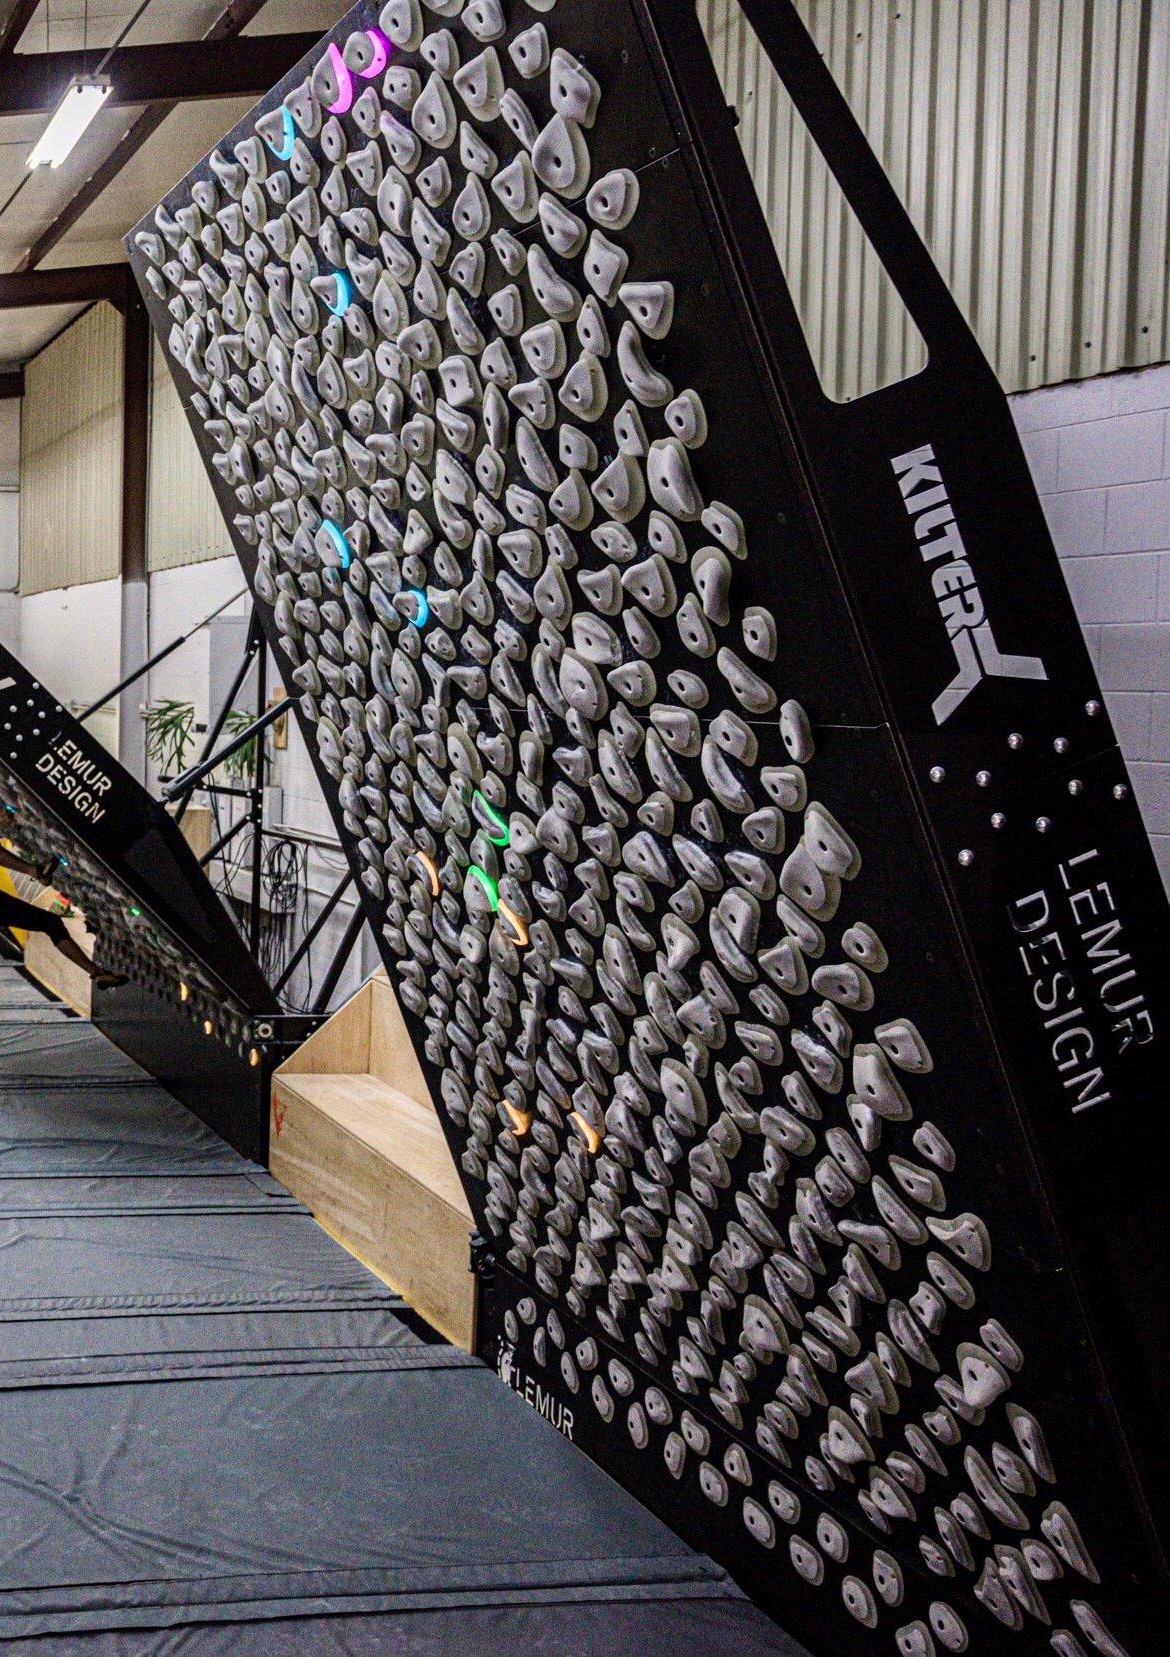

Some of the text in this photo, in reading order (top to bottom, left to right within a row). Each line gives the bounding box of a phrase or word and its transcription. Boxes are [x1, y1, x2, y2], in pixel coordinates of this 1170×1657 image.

[35, 753, 106, 824] DESIGN
[48, 731, 112, 797] LEMUR
[1058, 849, 1154, 1055] LEMUR
[1007, 890, 1111, 1113] DESIGN
[516, 1367, 574, 1441] LEMUR
